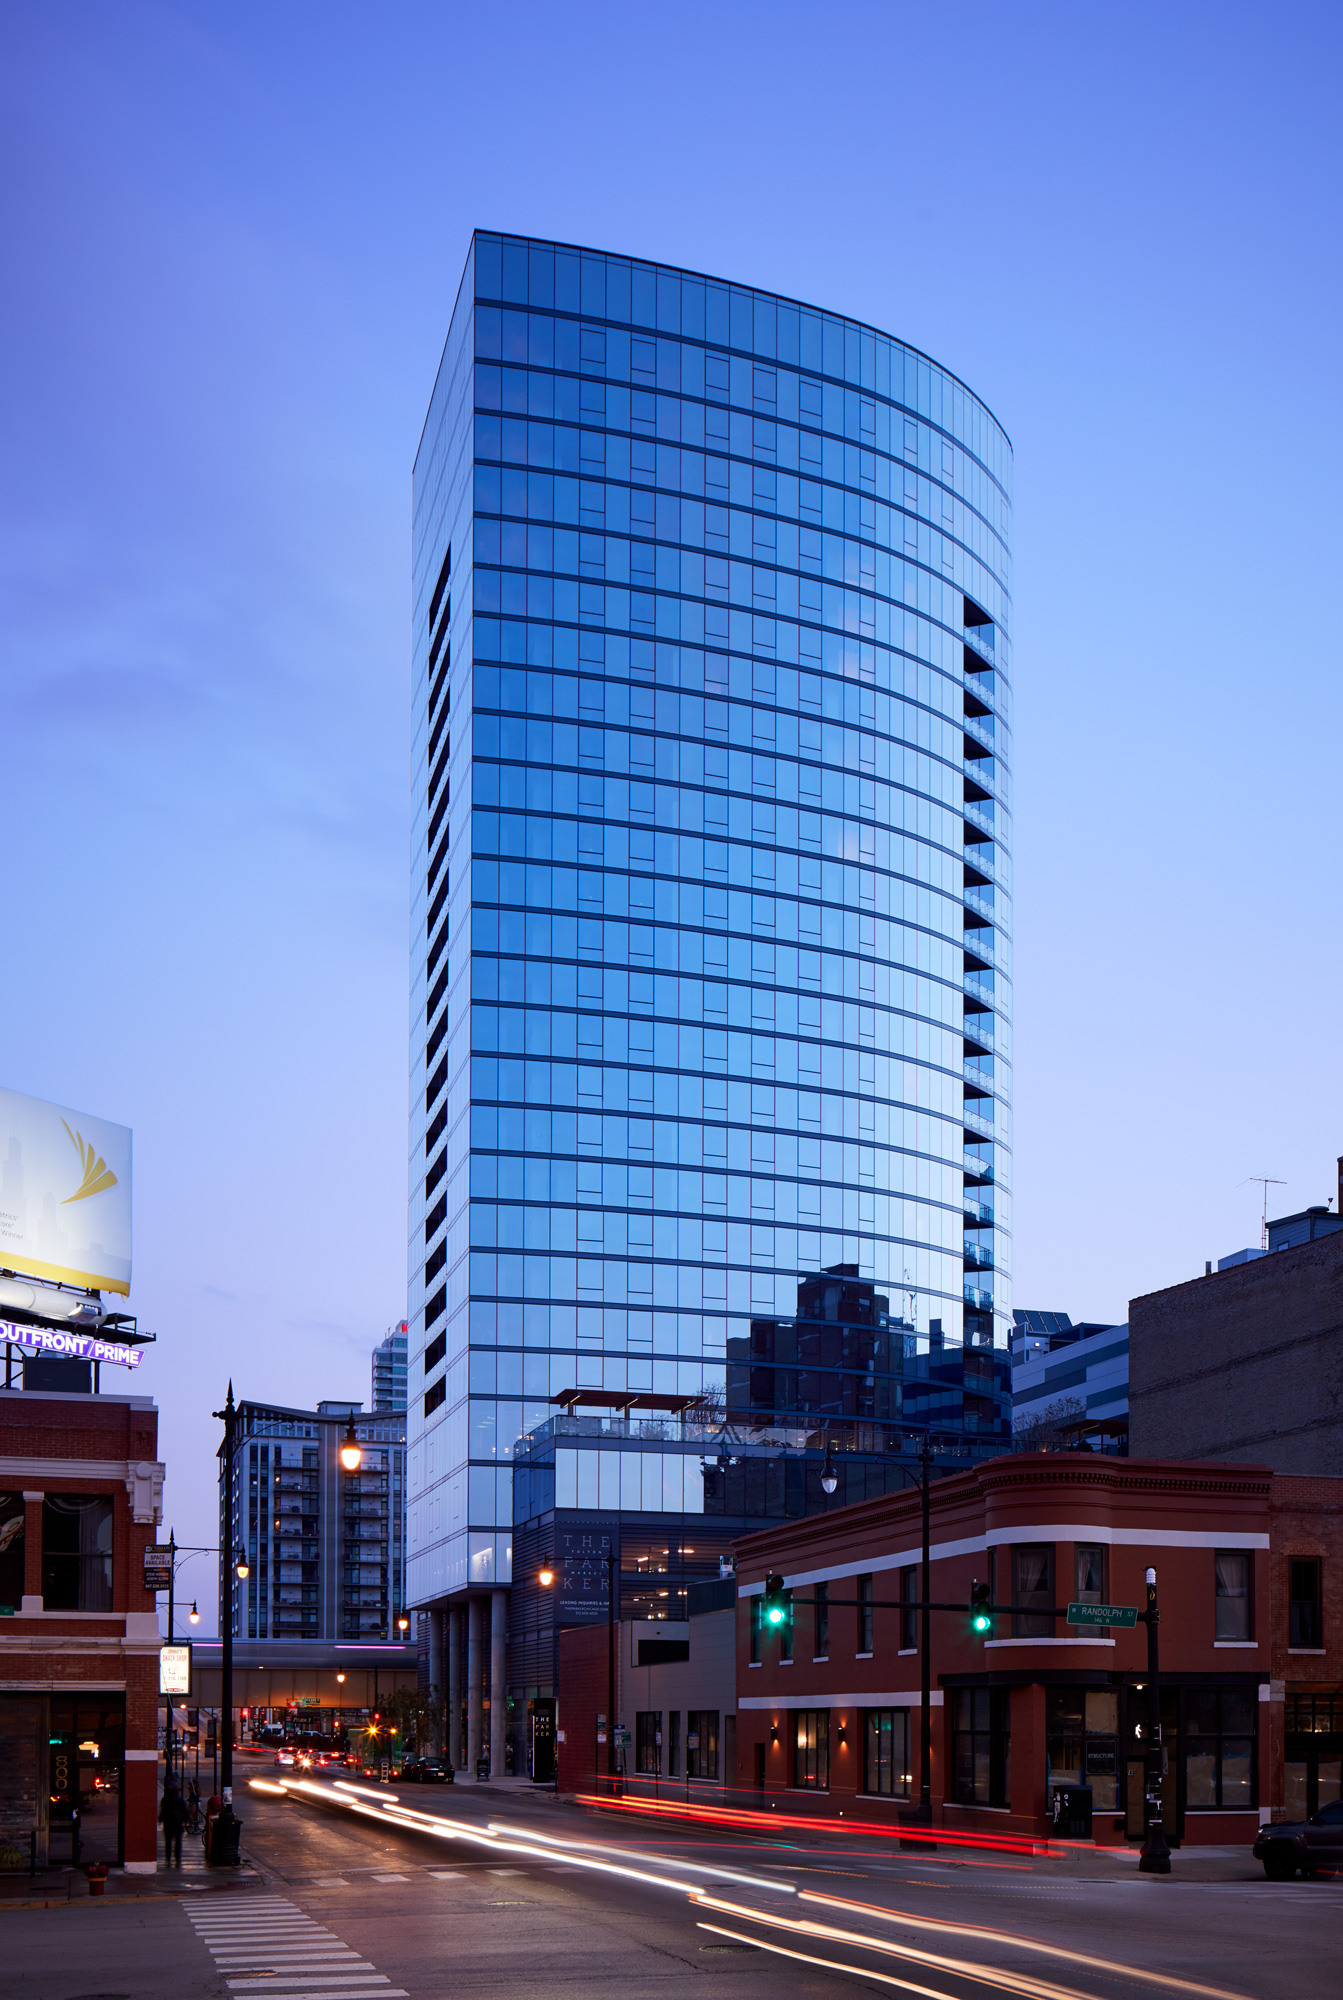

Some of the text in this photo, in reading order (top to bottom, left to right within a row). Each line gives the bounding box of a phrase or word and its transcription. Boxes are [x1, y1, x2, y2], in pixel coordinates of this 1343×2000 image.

[94, 1344, 139, 1365] PRIME
[563, 1535, 609, 1548] THE
[1081, 1607, 1122, 1617] RANDOLPH
